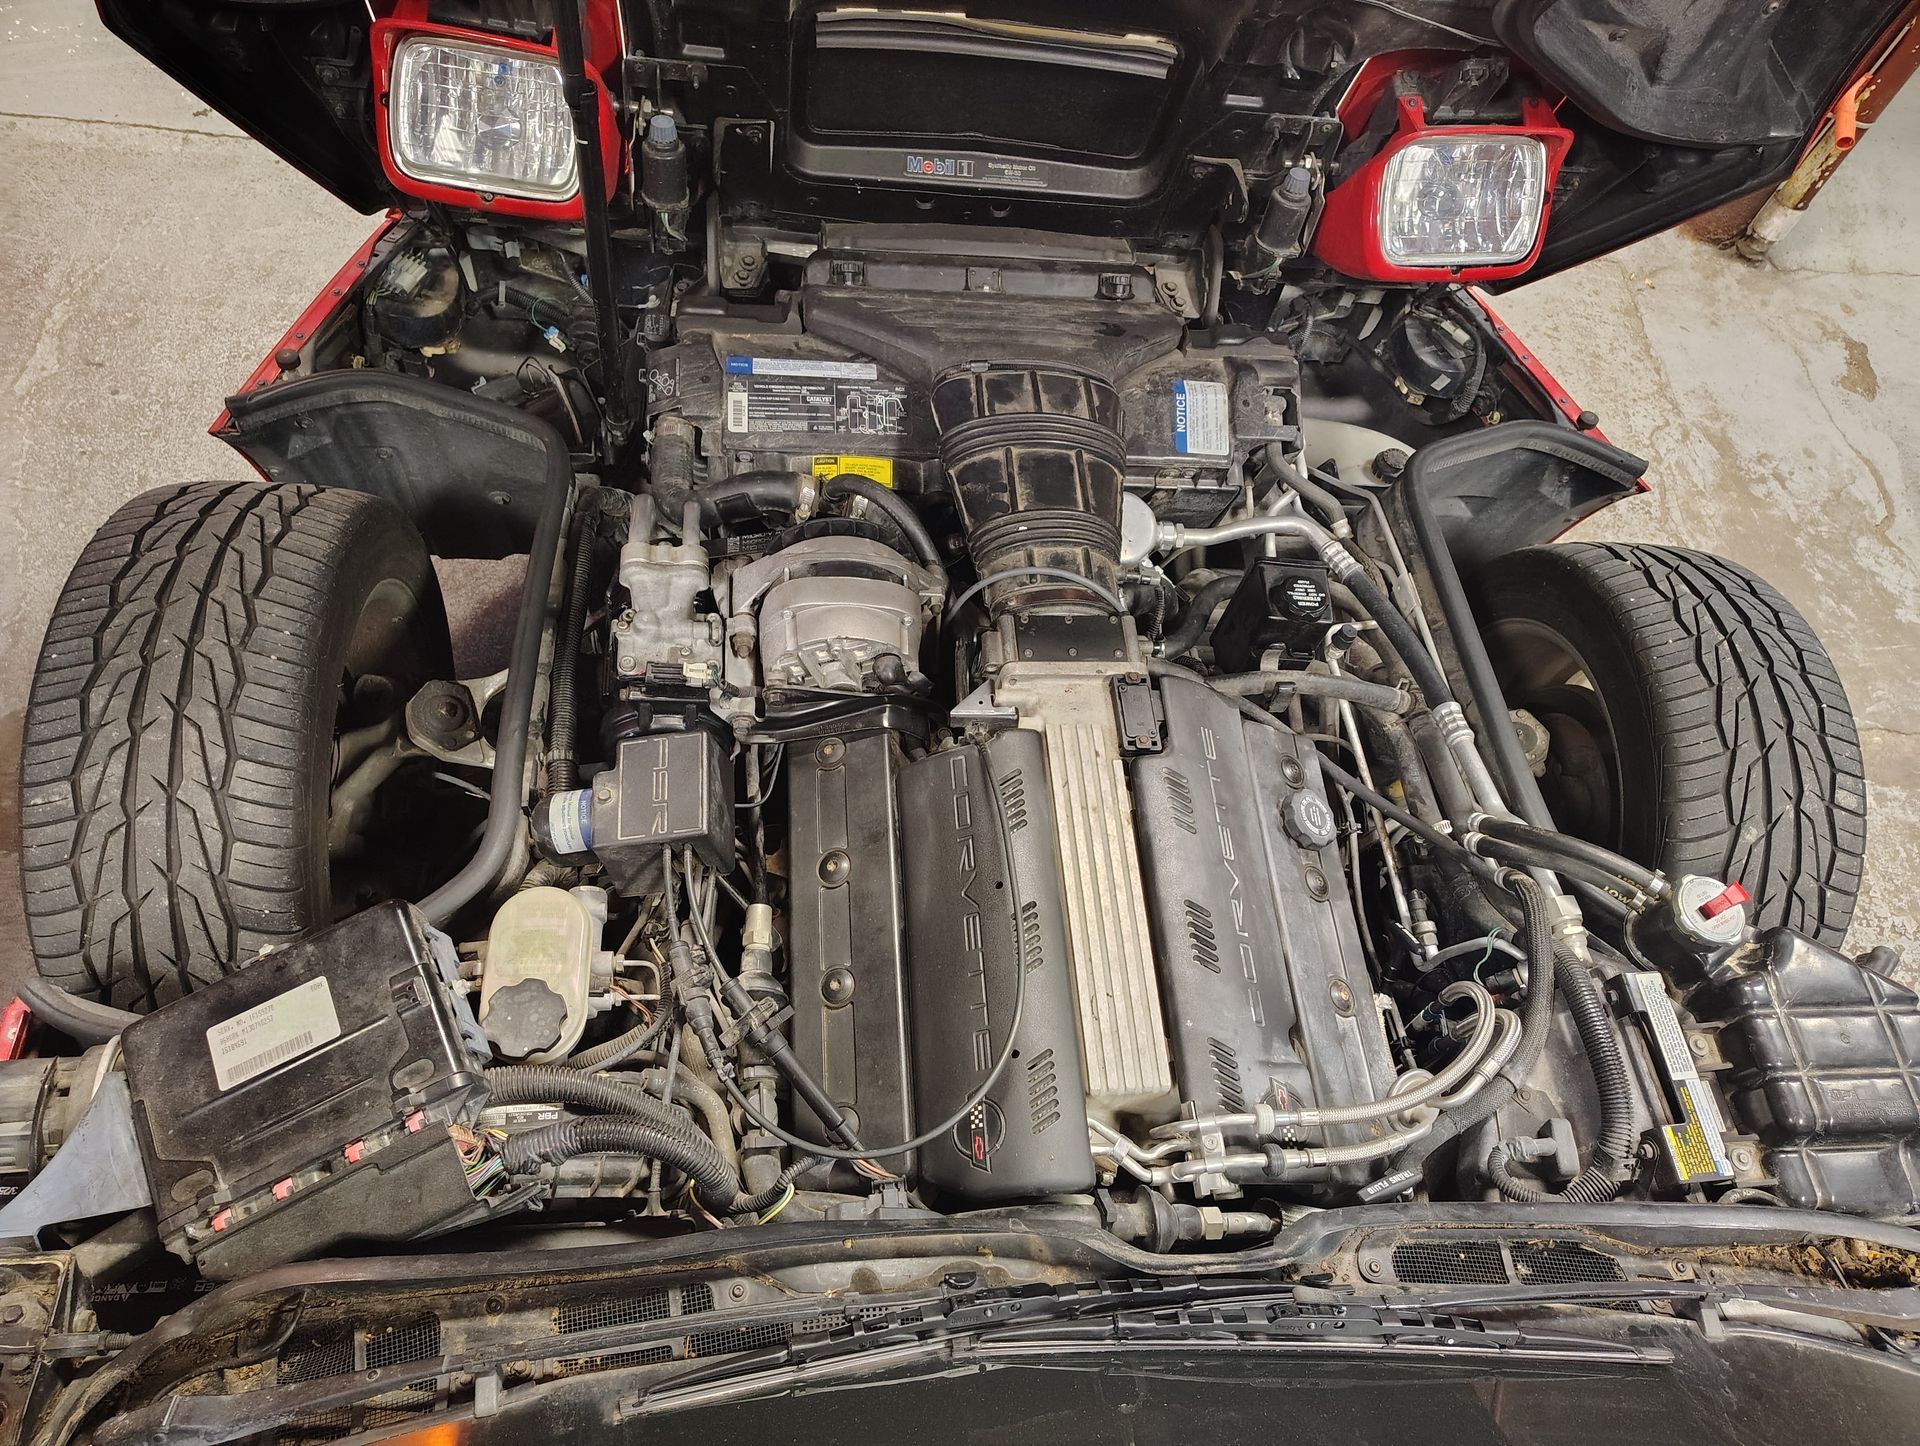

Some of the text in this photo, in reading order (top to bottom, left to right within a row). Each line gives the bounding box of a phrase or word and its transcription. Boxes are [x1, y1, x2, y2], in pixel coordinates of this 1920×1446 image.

[907, 155, 955, 176] Mobil
[1176, 393, 1186, 432] NOTICE
[651, 737, 668, 836] ASR
[580, 800, 588, 824] NOTICE
[1200, 726, 1266, 1028] CORVETTE
[950, 754, 993, 1072] CORVETTE
[1603, 886, 1646, 914] LOWR
[217, 1025, 234, 1036] SERV.
[236, 1018, 246, 1026] NO.
[537, 1111, 558, 1120] PBR
[1366, 1170, 1414, 1195] TRANS FLUID
